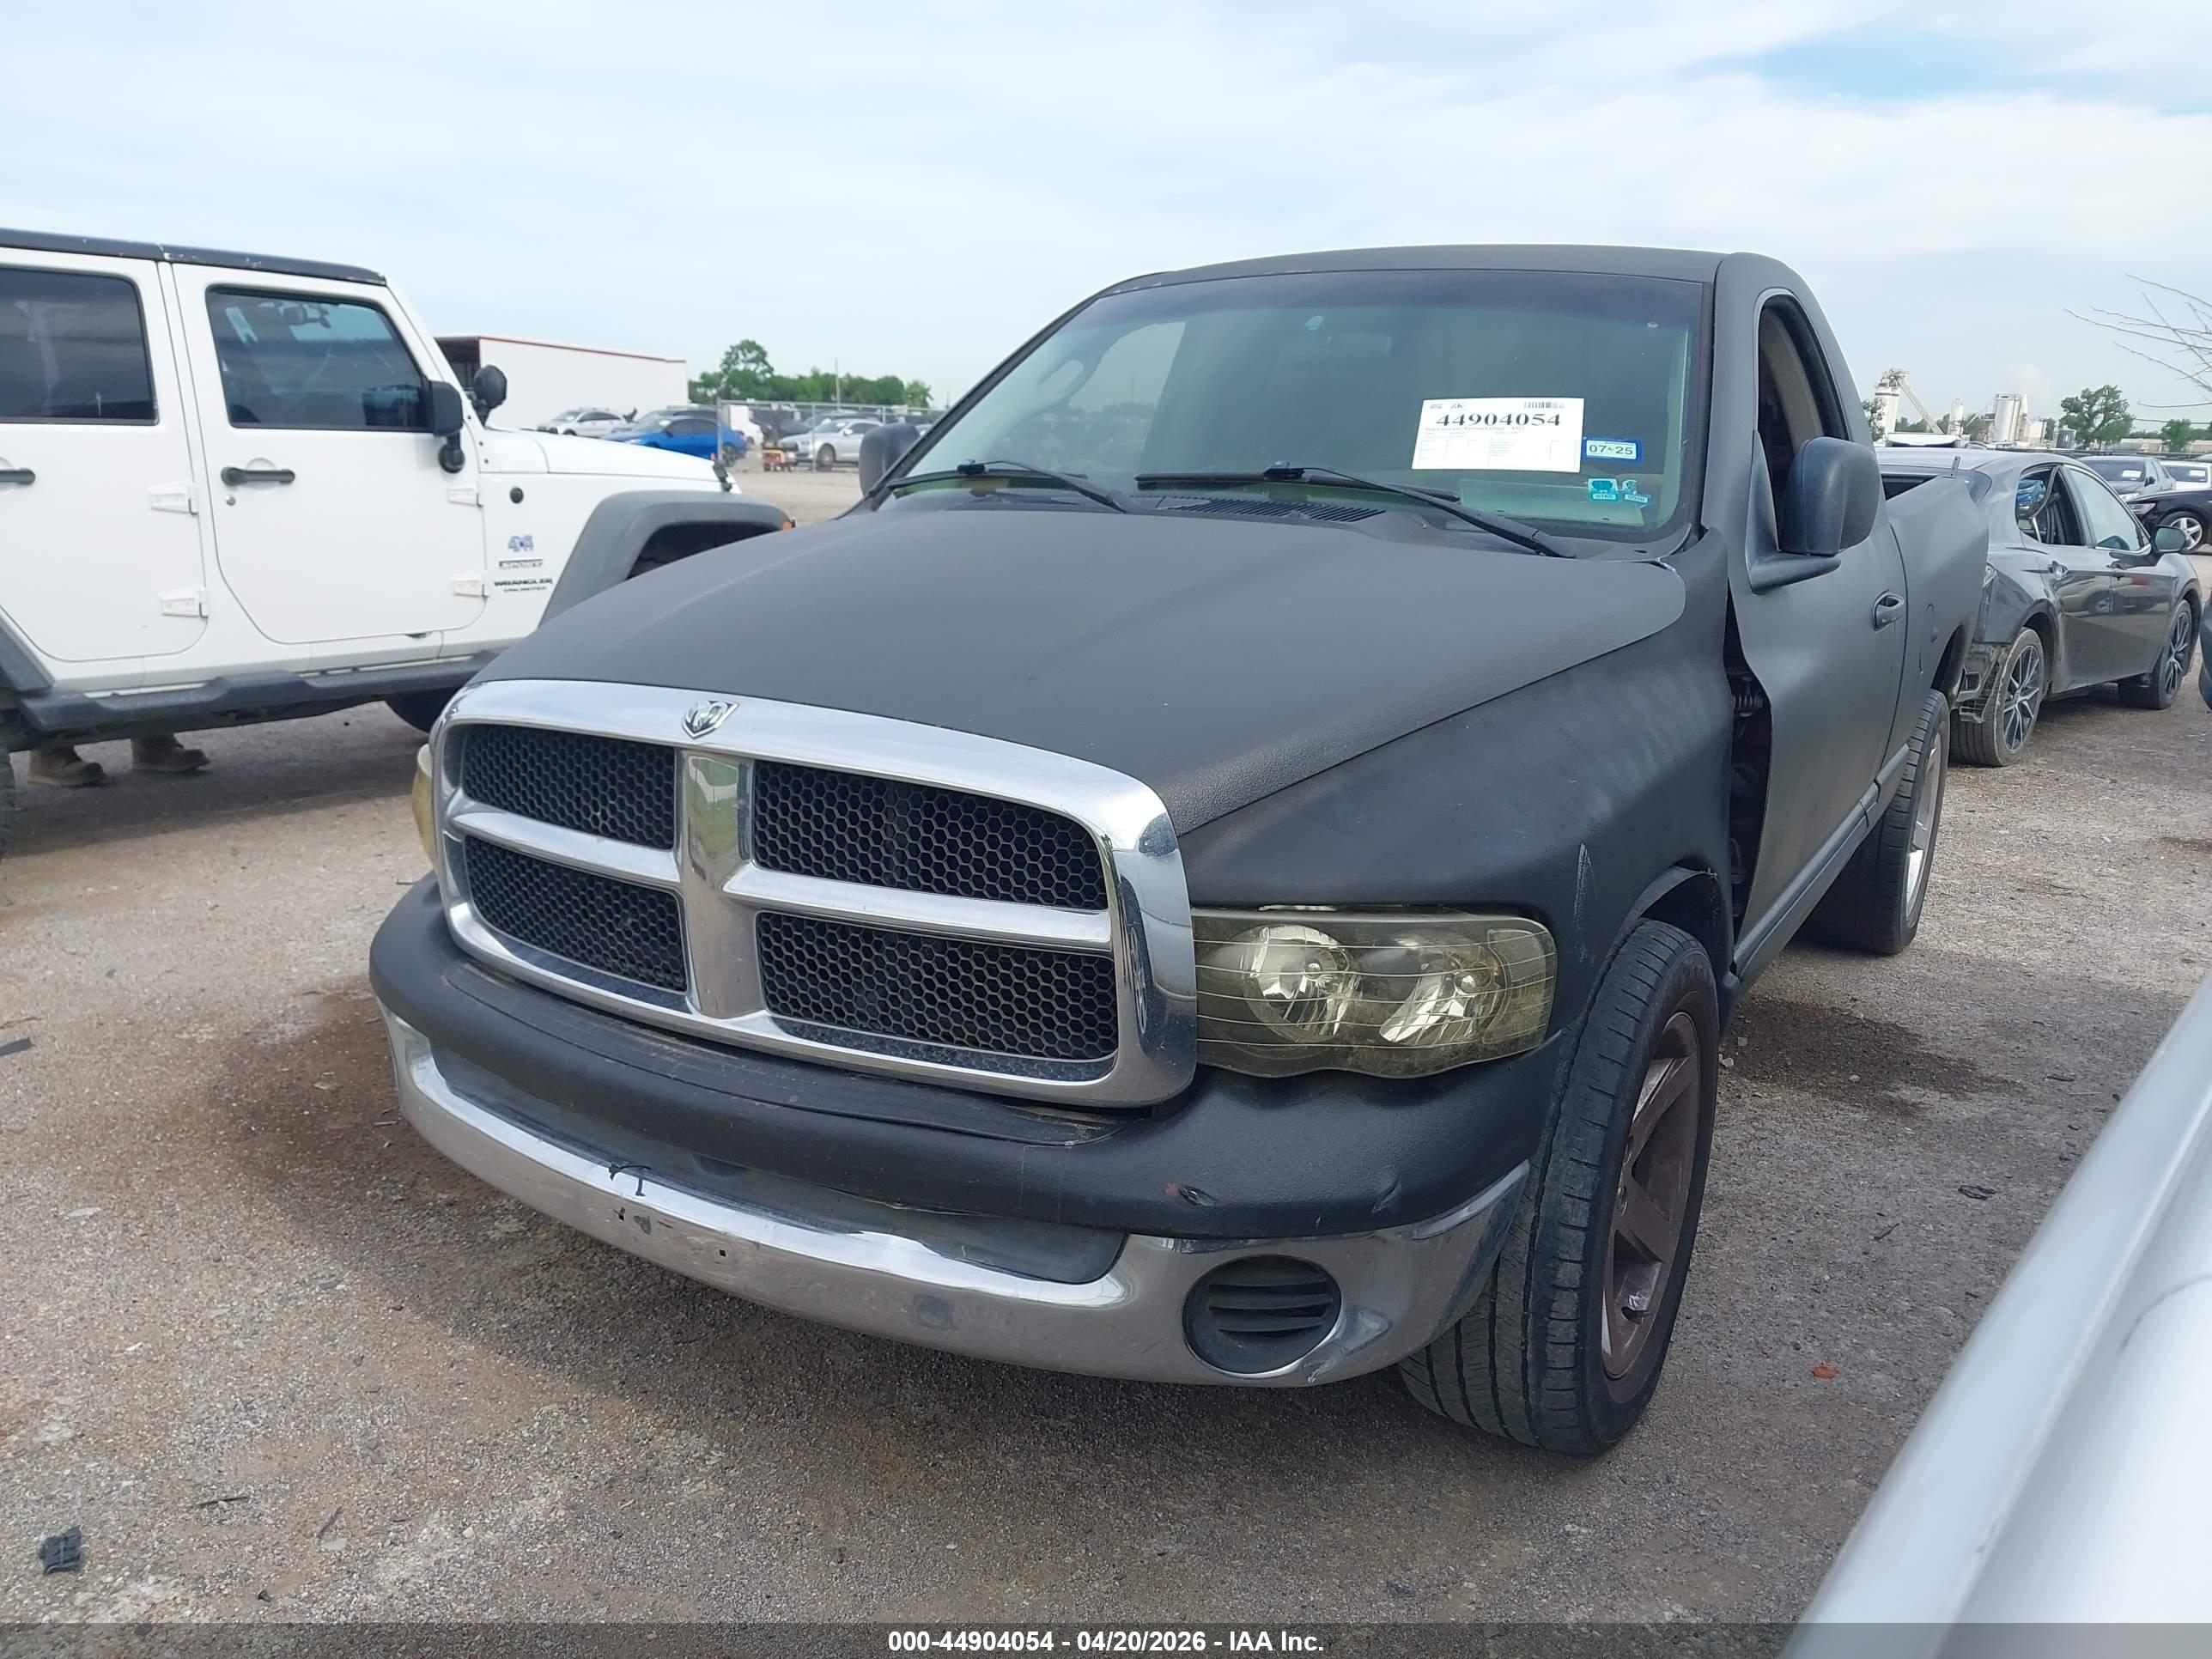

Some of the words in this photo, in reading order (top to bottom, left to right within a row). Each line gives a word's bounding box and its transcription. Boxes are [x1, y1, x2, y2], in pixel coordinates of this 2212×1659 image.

[1436, 413, 1561, 427] 44904054
[1589, 444, 1607, 453] 07
[1614, 446, 1633, 455] 25
